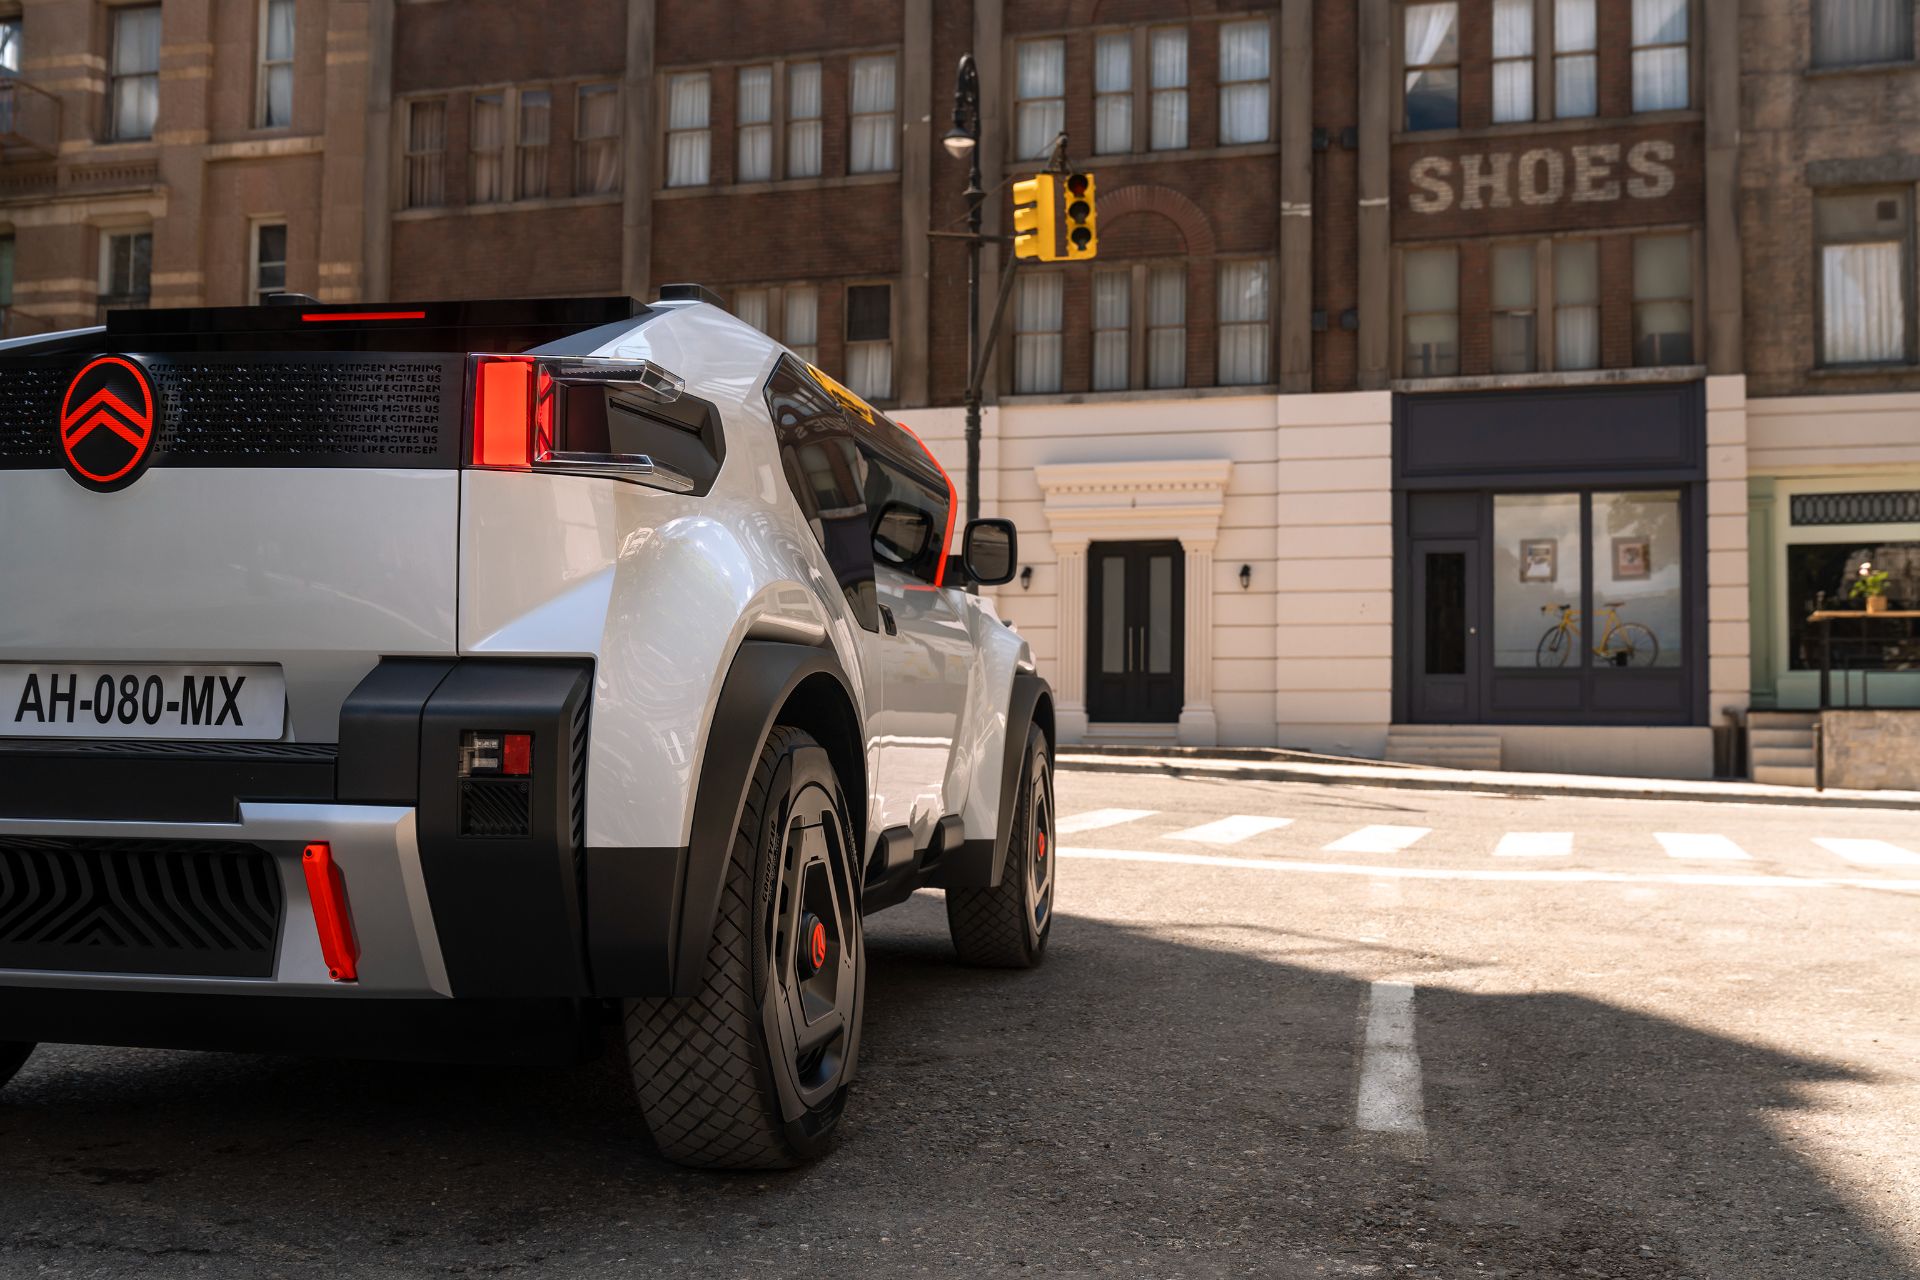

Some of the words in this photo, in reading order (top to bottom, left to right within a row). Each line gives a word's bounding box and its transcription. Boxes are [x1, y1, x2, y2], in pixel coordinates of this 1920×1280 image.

[1409, 140, 1675, 213] SHOES
[390, 364, 442, 372] NOTHING
[366, 384, 390, 392] LIKE
[392, 384, 440, 392] CITROEN
[382, 405, 421, 413] MOVES
[425, 405, 439, 413] US
[364, 415, 387, 423] LIKE
[390, 415, 438, 423] CITROEN
[386, 425, 438, 433] NOTHING
[380, 435, 419, 443] MOVES
[423, 435, 438, 443] US
[388, 446, 438, 454] CITROEN
[14, 673, 247, 726] AH-080-MX
